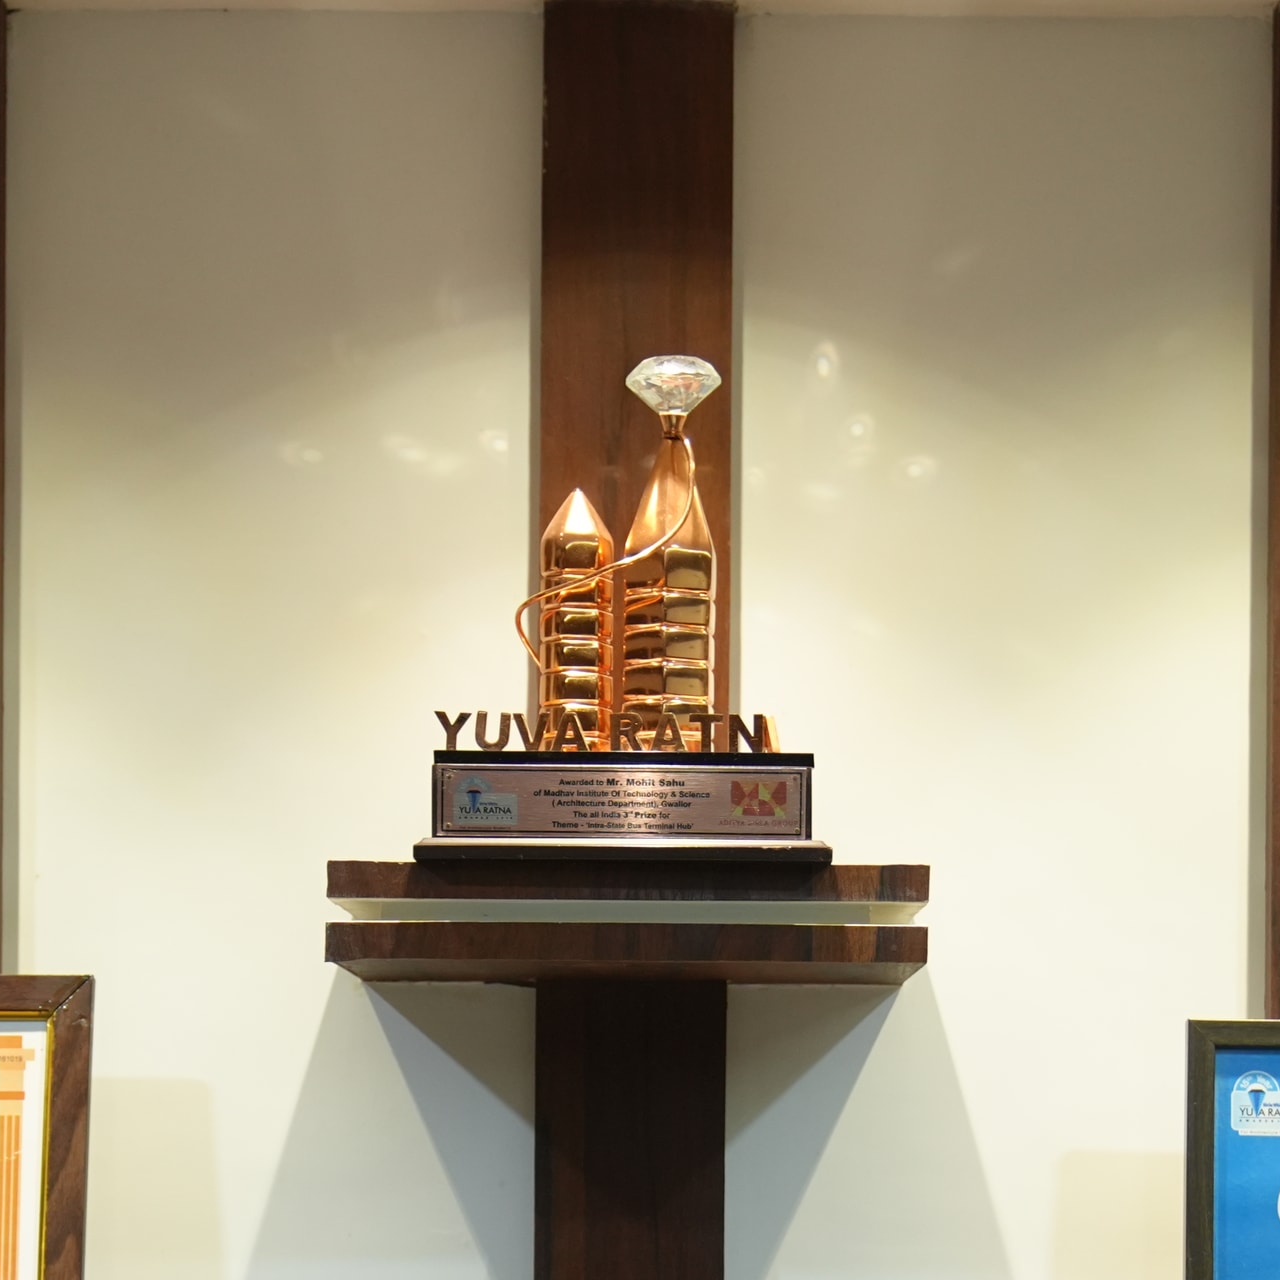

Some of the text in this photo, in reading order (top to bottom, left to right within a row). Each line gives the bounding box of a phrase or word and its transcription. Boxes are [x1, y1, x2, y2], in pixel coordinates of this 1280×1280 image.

[434, 710, 767, 753] YUVA RATN
[659, 779, 685, 787] Sahu
[533, 789, 541, 797] of
[483, 806, 512, 814] RATNA
